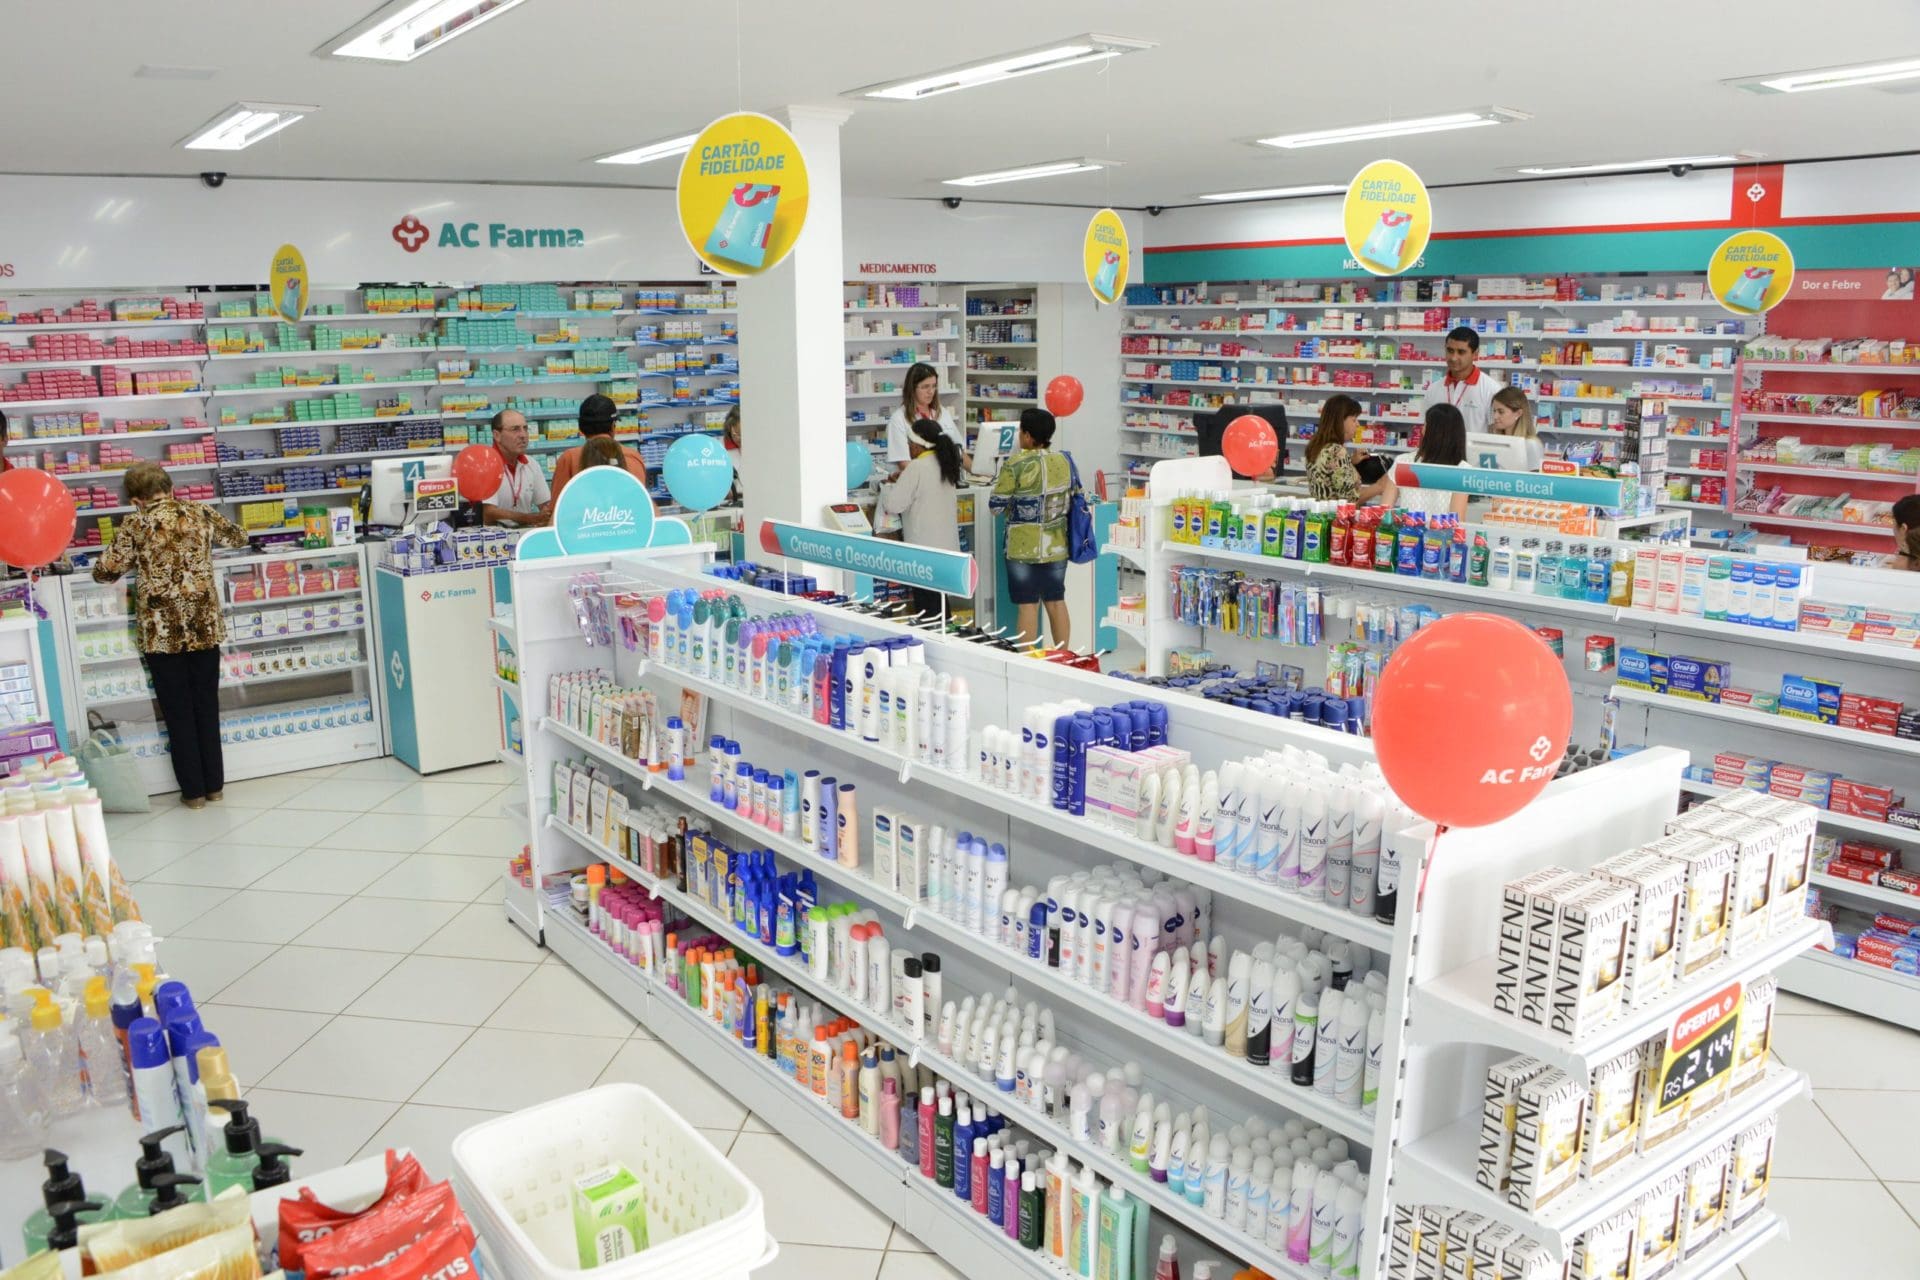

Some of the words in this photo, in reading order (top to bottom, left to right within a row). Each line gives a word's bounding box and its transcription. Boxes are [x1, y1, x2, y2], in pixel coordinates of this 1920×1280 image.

[702, 140, 760, 160] CARTÃO
[700, 155, 785, 176] FIDELIDADE
[1362, 179, 1401, 192] CARTÃO
[1360, 191, 1417, 204] FIDELIDADE
[438, 223, 480, 248] AC
[489, 223, 585, 248] Farma
[1725, 253, 1780, 263] FIDELIDADE
[1726, 245, 1765, 255] CARTÃO
[859, 263, 937, 274] MEDICAMENTOS
[1802, 280, 1820, 290] Dor
[1832, 280, 1861, 289] Febre
[1001, 429, 1012, 447] 2
[406, 463, 423, 481] 4
[1462, 475, 1512, 493] Higiene
[1515, 480, 1553, 496] Bucal
[790, 535, 833, 560] Cremes
[835, 548, 842, 561] e
[845, 545, 933, 581] Desodorantes
[433, 591, 446, 600] AC
[448, 588, 476, 597] Farma
[1803, 616, 1829, 626] Colgate
[1865, 625, 1896, 635] Colgate
[1722, 691, 1749, 701] Colgate
[1716, 757, 1743, 768] Colgate
[1480, 768, 1514, 785] AC
[1714, 772, 1742, 783] Colgate
[1773, 768, 1802, 779] Colgate
[1771, 783, 1800, 794] Colgate
[1881, 874, 1918, 890] closeup
[1590, 897, 1634, 933] PANTENE
[1876, 917, 1911, 930] Colgate
[1494, 889, 1526, 1015] PANTENE
[1859, 938, 1894, 952] Colgate
[1521, 897, 1556, 1025] PANTENE
[1858, 949, 1894, 965] Colgate
[1551, 906, 1587, 1036] PANTENE
[1676, 1003, 1720, 1040] OFERTA
[1663, 1077, 1682, 1102] R$
[1476, 1068, 1508, 1193] PANTENE
[1508, 1092, 1542, 1213] PANTENE
